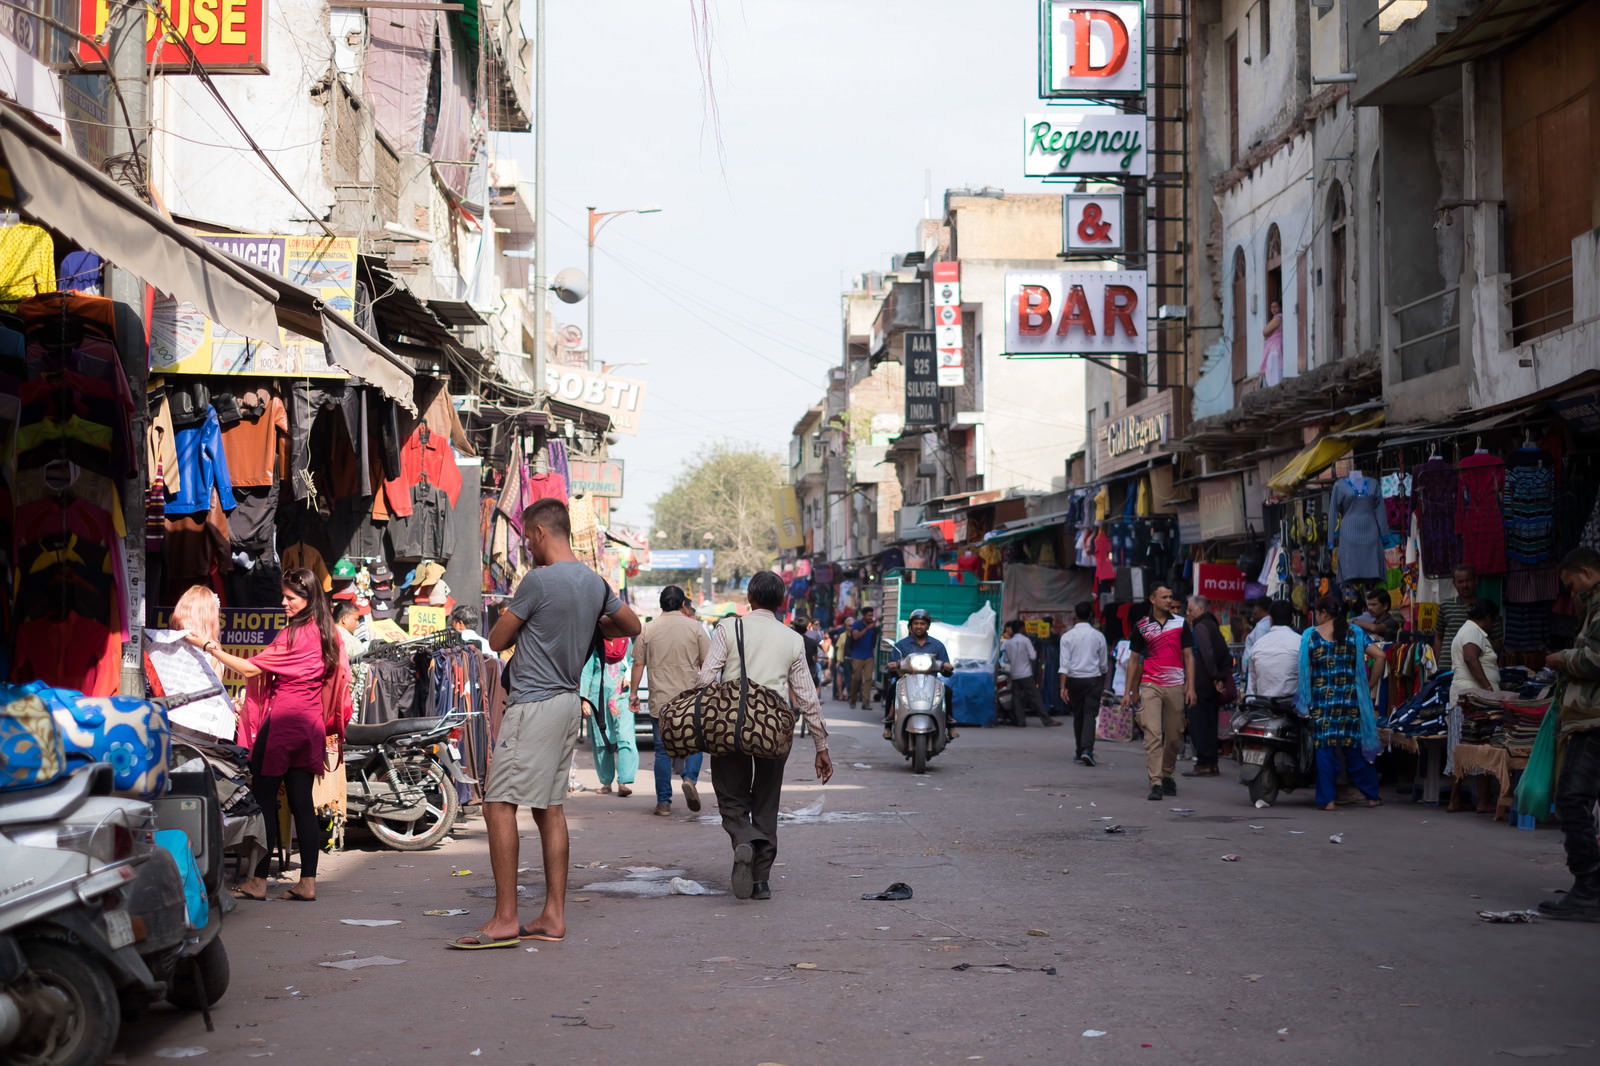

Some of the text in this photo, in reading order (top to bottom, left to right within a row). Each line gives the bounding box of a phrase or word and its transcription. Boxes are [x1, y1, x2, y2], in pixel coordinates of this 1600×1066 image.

[1069, 9, 1129, 77] D
[1029, 121, 1142, 169] Regency
[1077, 203, 1112, 243] &
[1018, 284, 1138, 337] BAR
[912, 336, 932, 352] AAA
[913, 359, 930, 375] 925
[544, 366, 641, 412] SOBTI
[907, 381, 937, 397] SILVER
[910, 403, 934, 420] INDIA
[1129, 413, 1164, 455] Regency
[233, 612, 288, 630] HOTE
[417, 612, 436, 624] SALE
[227, 631, 265, 643] HOUSE
